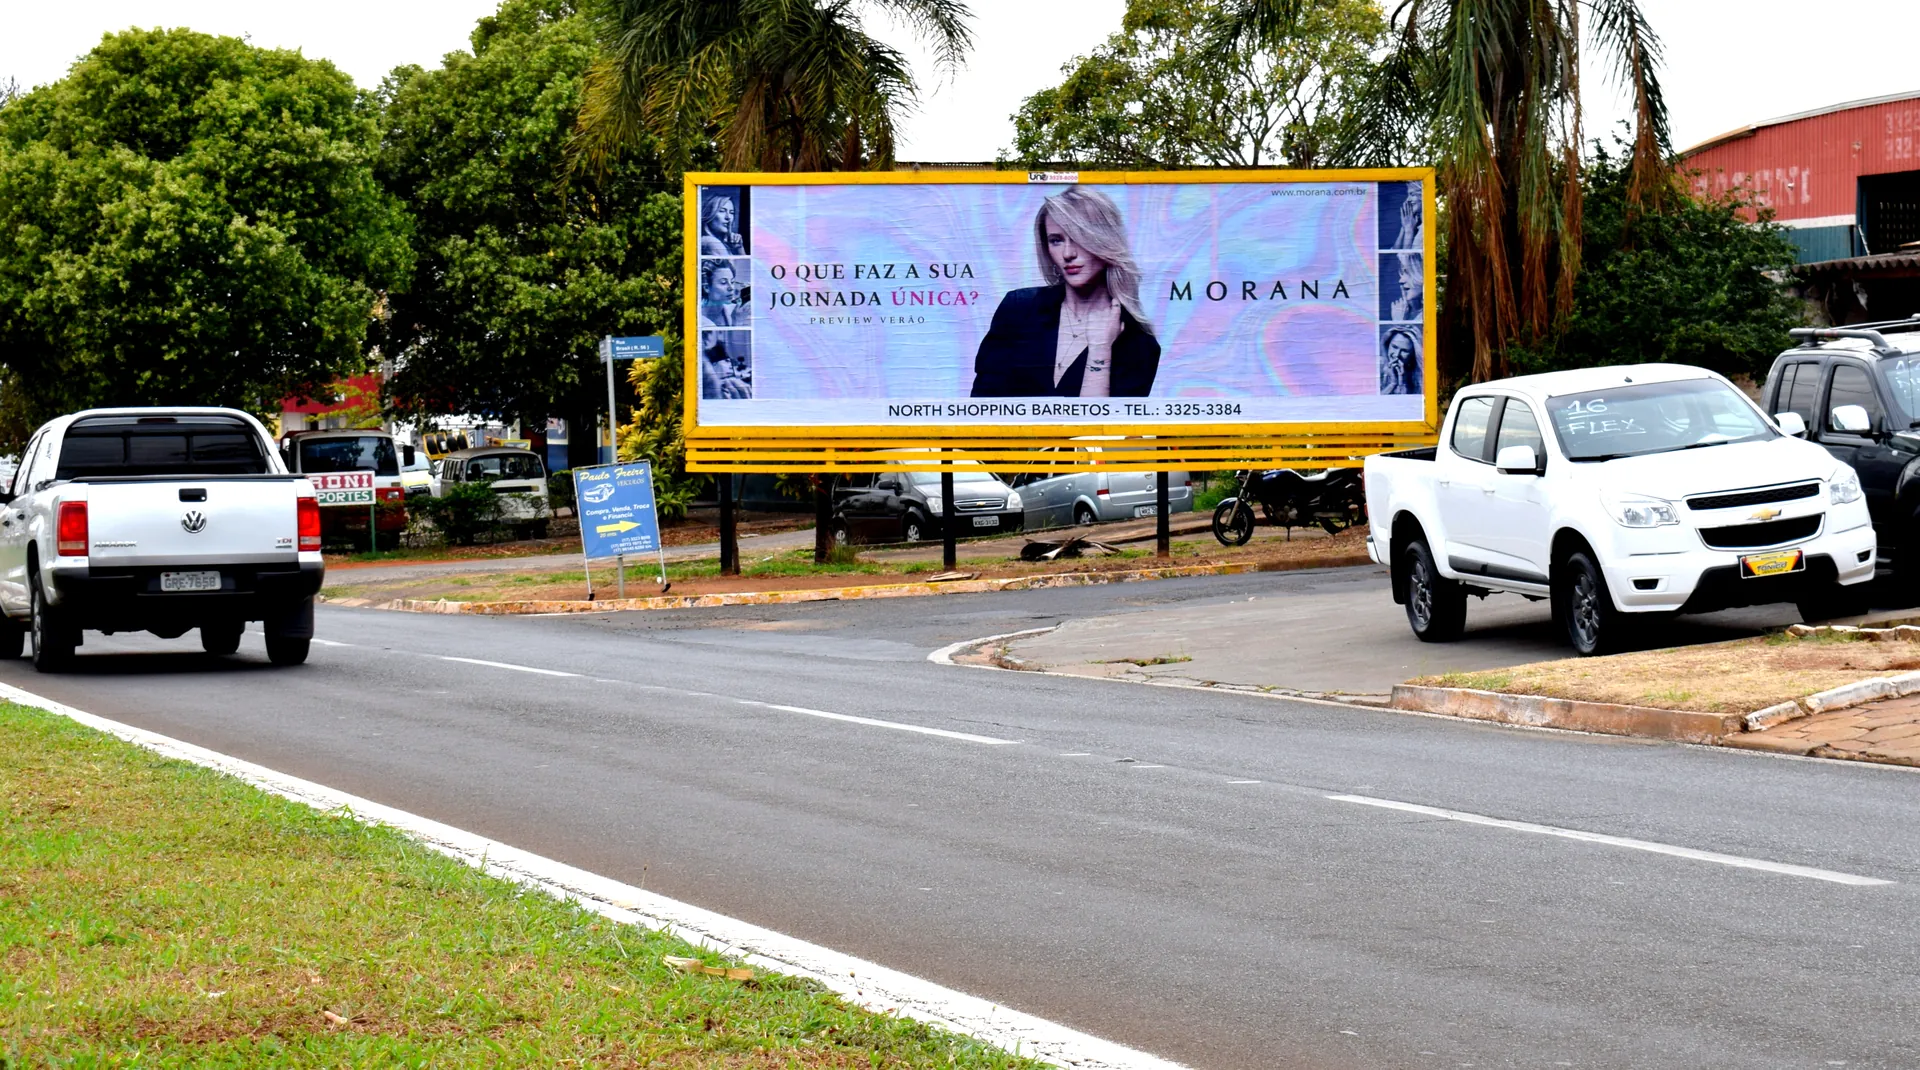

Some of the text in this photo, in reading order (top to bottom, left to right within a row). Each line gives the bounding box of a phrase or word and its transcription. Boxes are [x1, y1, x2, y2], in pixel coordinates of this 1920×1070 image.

[1271, 187, 1367, 198] www.morana.com.br
[770, 263, 975, 282] O QUE FAZ A SUA
[770, 286, 980, 310] JORNADA ÚNICA?
[1169, 279, 1351, 302] MORANA
[809, 314, 926, 325] PREVIEW VERÃO
[888, 405, 943, 417] NORTH
[948, 404, 1027, 417] SHOPPING
[1032, 404, 1110, 416] BARRETOS
[1124, 404, 1160, 416] TEL.:
[1164, 403, 1242, 416] 3325-3384
[1567, 398, 1608, 416] 16
[1567, 418, 1645, 435] FLEX
[579, 467, 645, 483] Paulo Freire
[316, 490, 370, 502] PORTES
